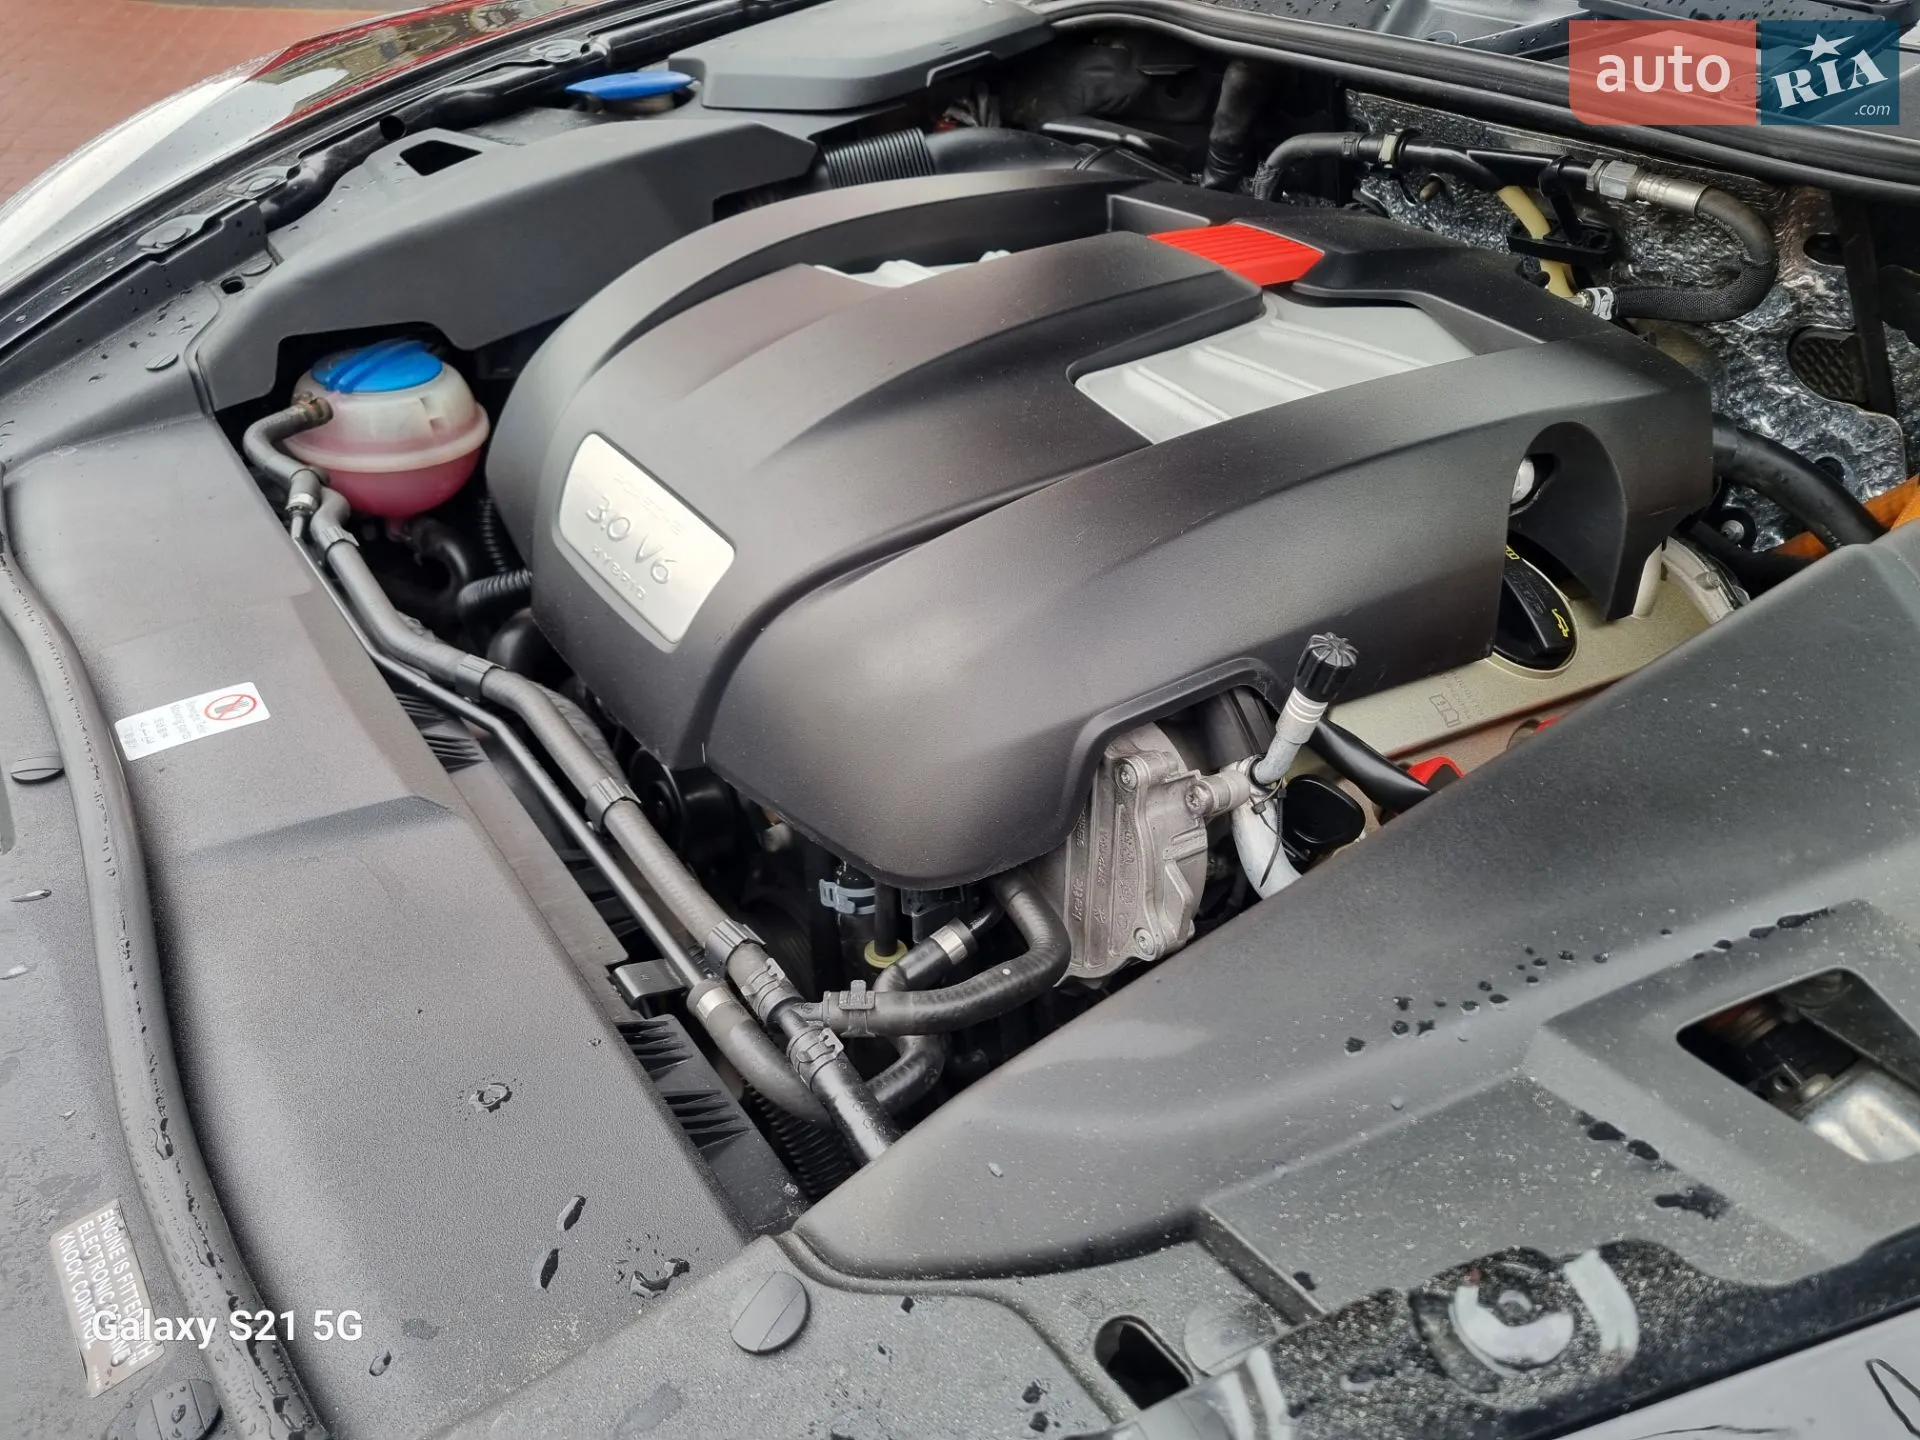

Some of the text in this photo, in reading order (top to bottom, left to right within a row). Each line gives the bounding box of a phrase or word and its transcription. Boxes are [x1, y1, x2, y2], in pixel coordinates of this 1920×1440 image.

[585, 495, 631, 542] 3.0
[634, 533, 678, 585] V6
[59, 1231, 85, 1282] KNOCK
[96, 1209, 126, 1260] ENGINE
[78, 1220, 115, 1304] ELECTRONIC
[113, 1257, 130, 1274] IS
[117, 1272, 143, 1322] FITTED
